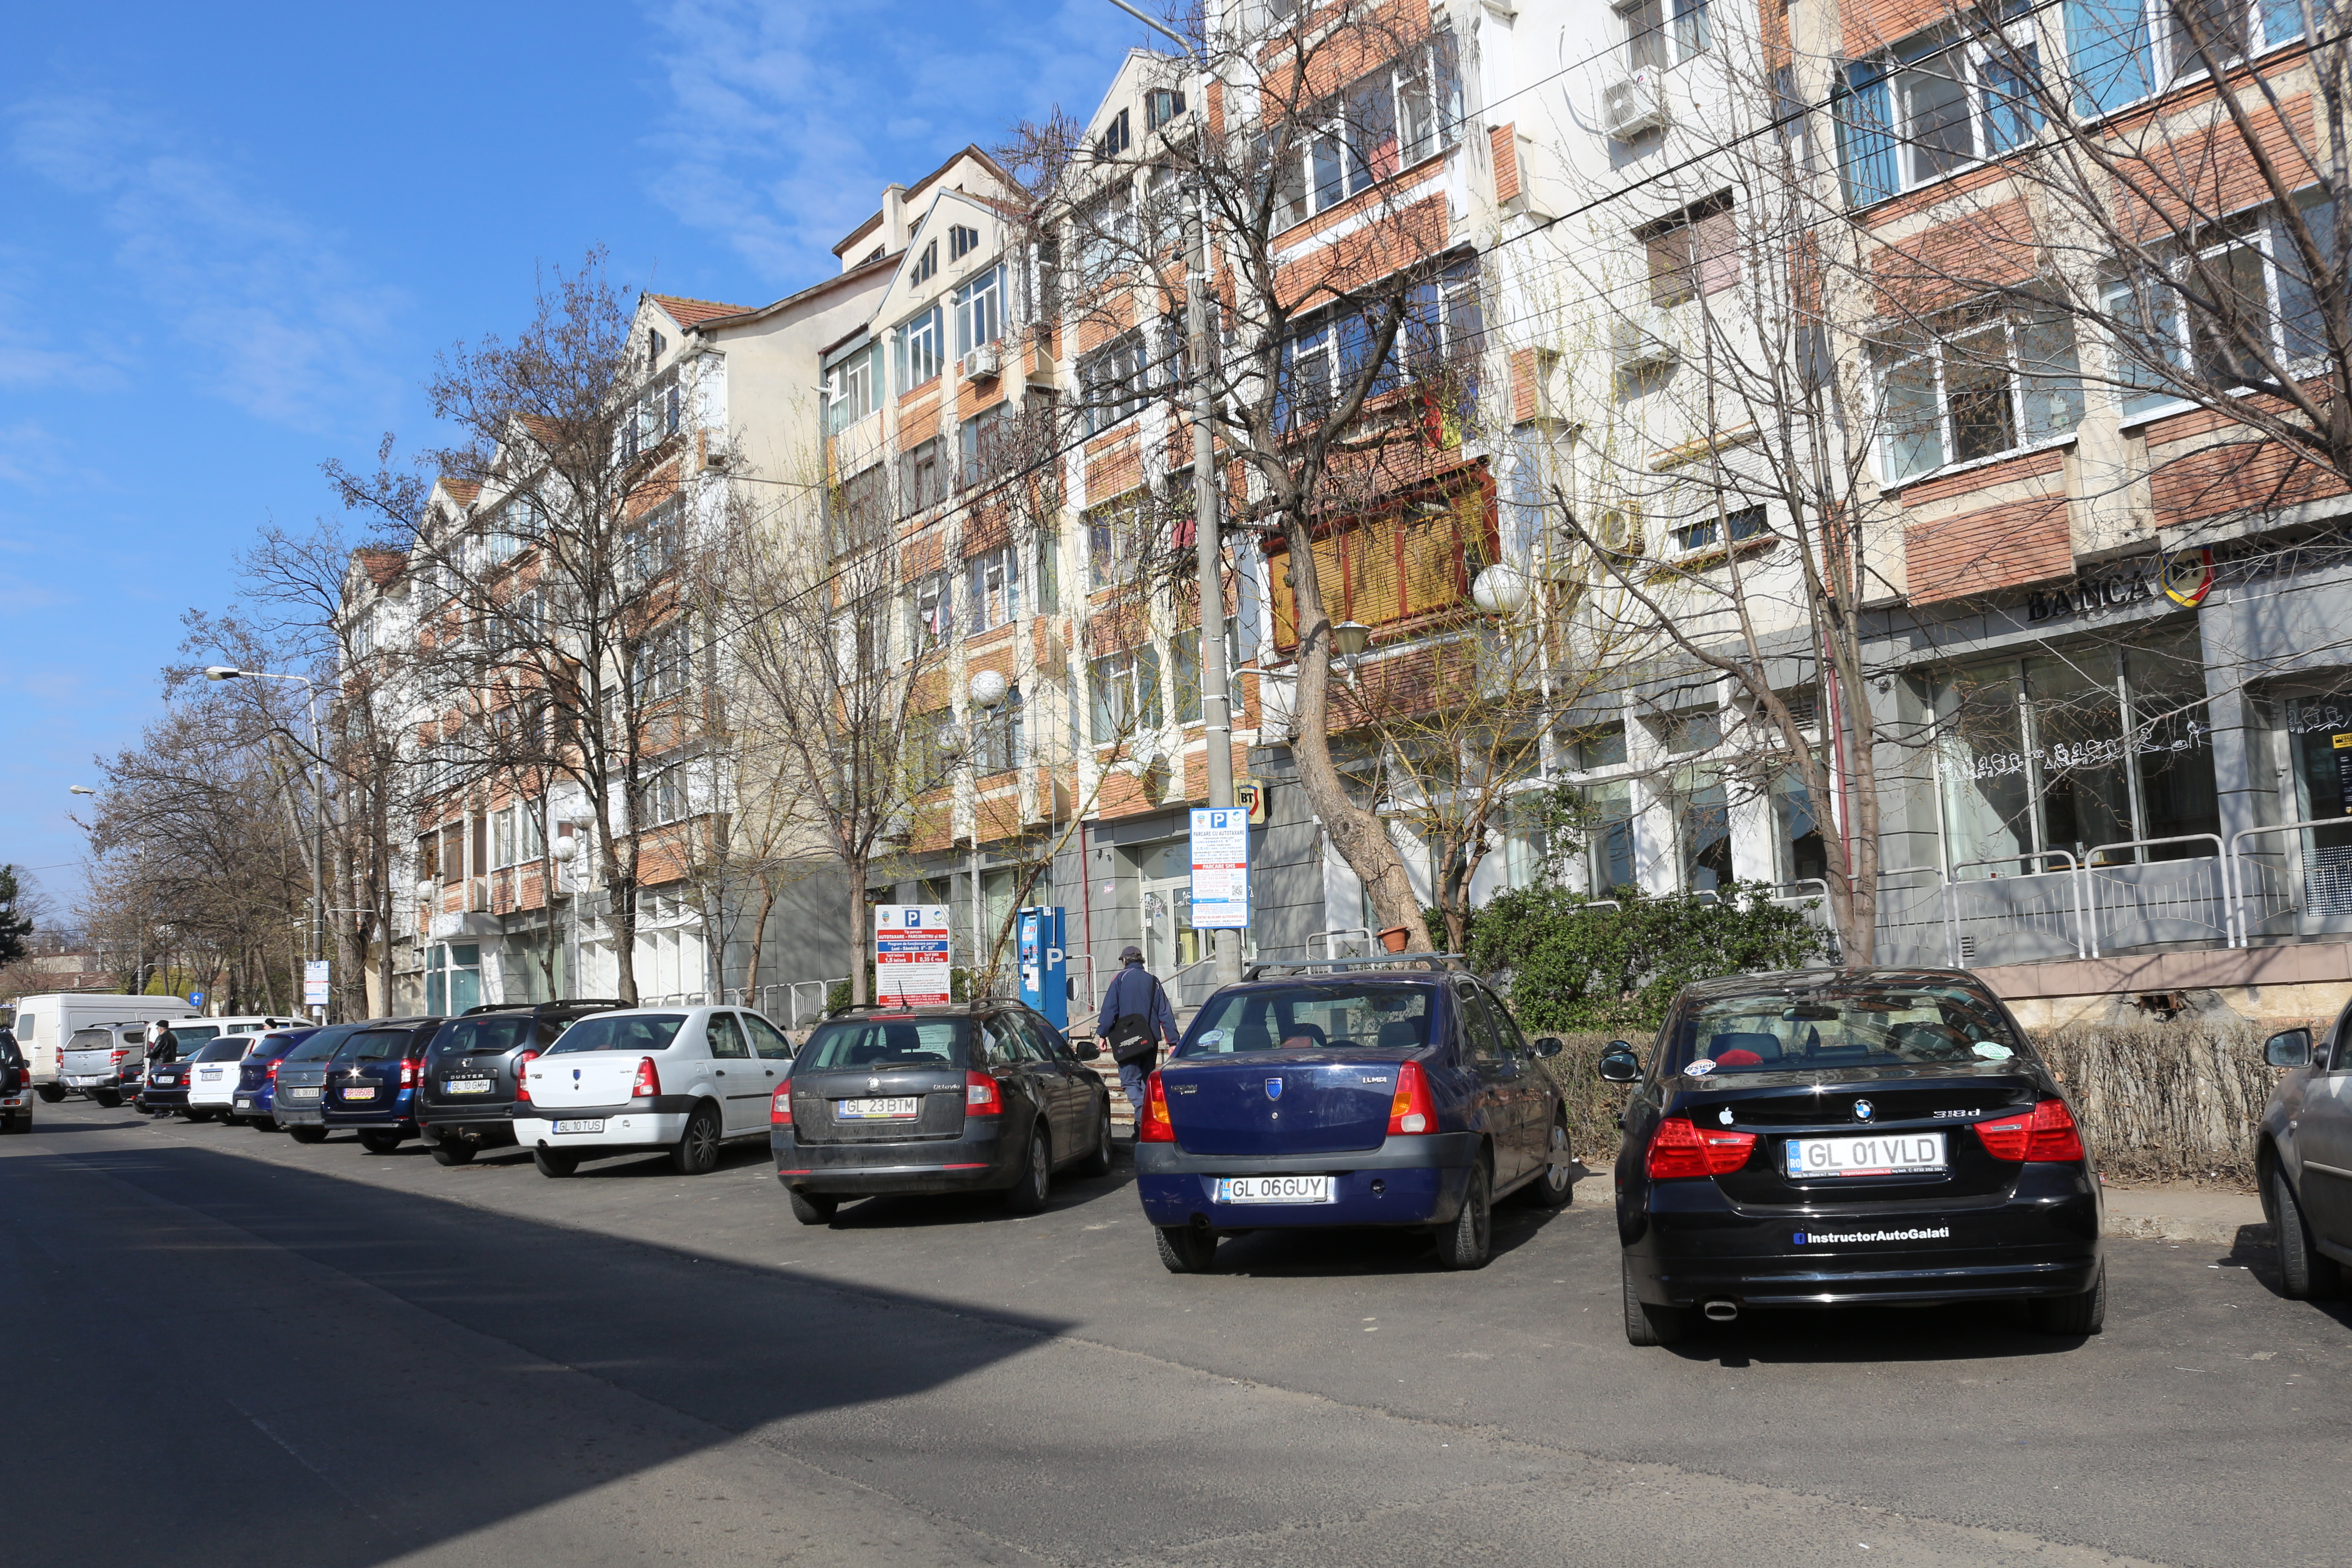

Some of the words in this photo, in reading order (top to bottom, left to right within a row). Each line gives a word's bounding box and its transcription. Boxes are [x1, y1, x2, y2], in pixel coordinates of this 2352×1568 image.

[2171, 557, 2200, 582] BT
[2025, 570, 2157, 622] BANCA
[1240, 793, 1254, 803] BT
[1214, 813, 1224, 827] P
[908, 912, 918, 926] P
[1047, 948, 1063, 971] P
[472, 1081, 488, 1089] GMH
[847, 1100, 862, 1112] GL
[869, 1099, 884, 1112] 23
[887, 1099, 913, 1112] BTM
[559, 1122, 569, 1131] GL
[573, 1122, 581, 1130] 10
[583, 1121, 600, 1130] TUS
[1808, 1144, 1842, 1167] GL
[1852, 1141, 1877, 1166] 01
[1883, 1138, 1936, 1163] VLD
[1790, 1158, 1801, 1168] RO
[1233, 1180, 1254, 1197] GL
[1261, 1179, 1281, 1196] 06
[1284, 1179, 1321, 1196] GUY
[1808, 1227, 1949, 1243] InstructorAutoGalati
